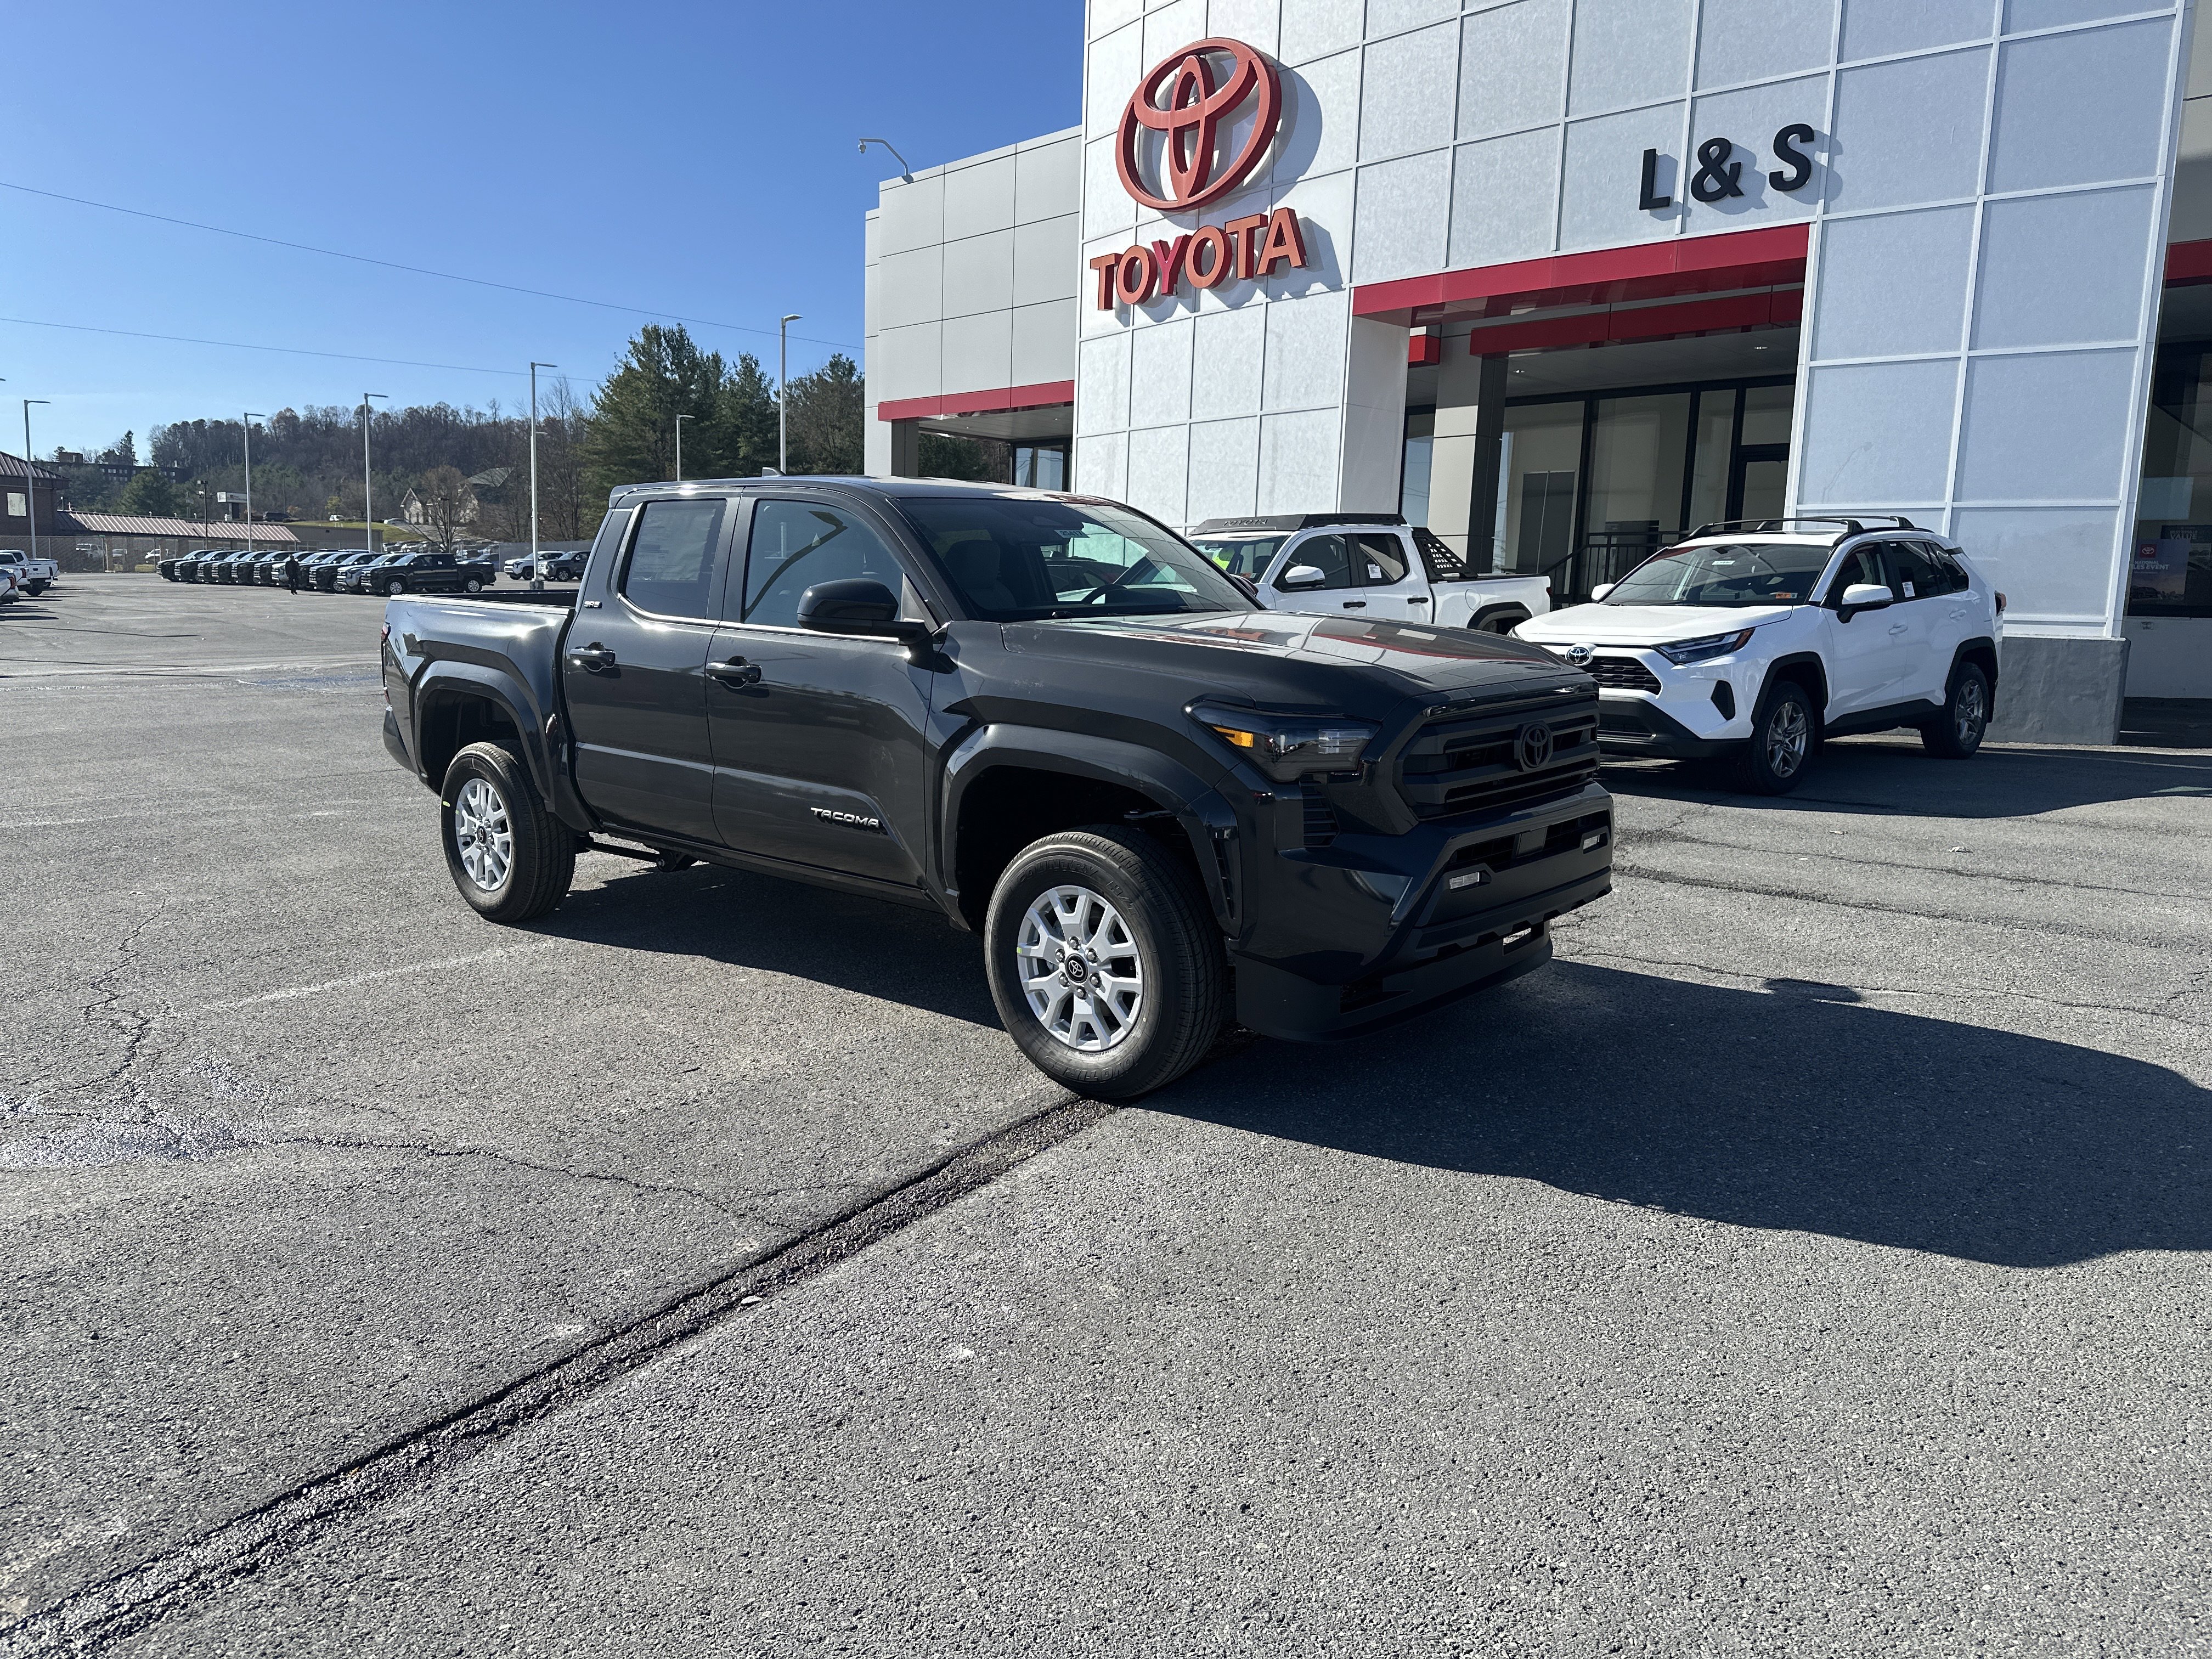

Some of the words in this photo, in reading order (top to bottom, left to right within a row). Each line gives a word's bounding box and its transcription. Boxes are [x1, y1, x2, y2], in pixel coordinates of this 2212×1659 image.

[1639, 148, 1671, 211] L
[1690, 137, 1745, 202] &
[1769, 123, 1815, 192] S
[1090, 207, 1308, 311] TOYOTA
[1222, 518, 1268, 527] TOYOTA
[810, 807, 879, 828] TACOMA
[1016, 858, 1099, 884] COUNTRY
